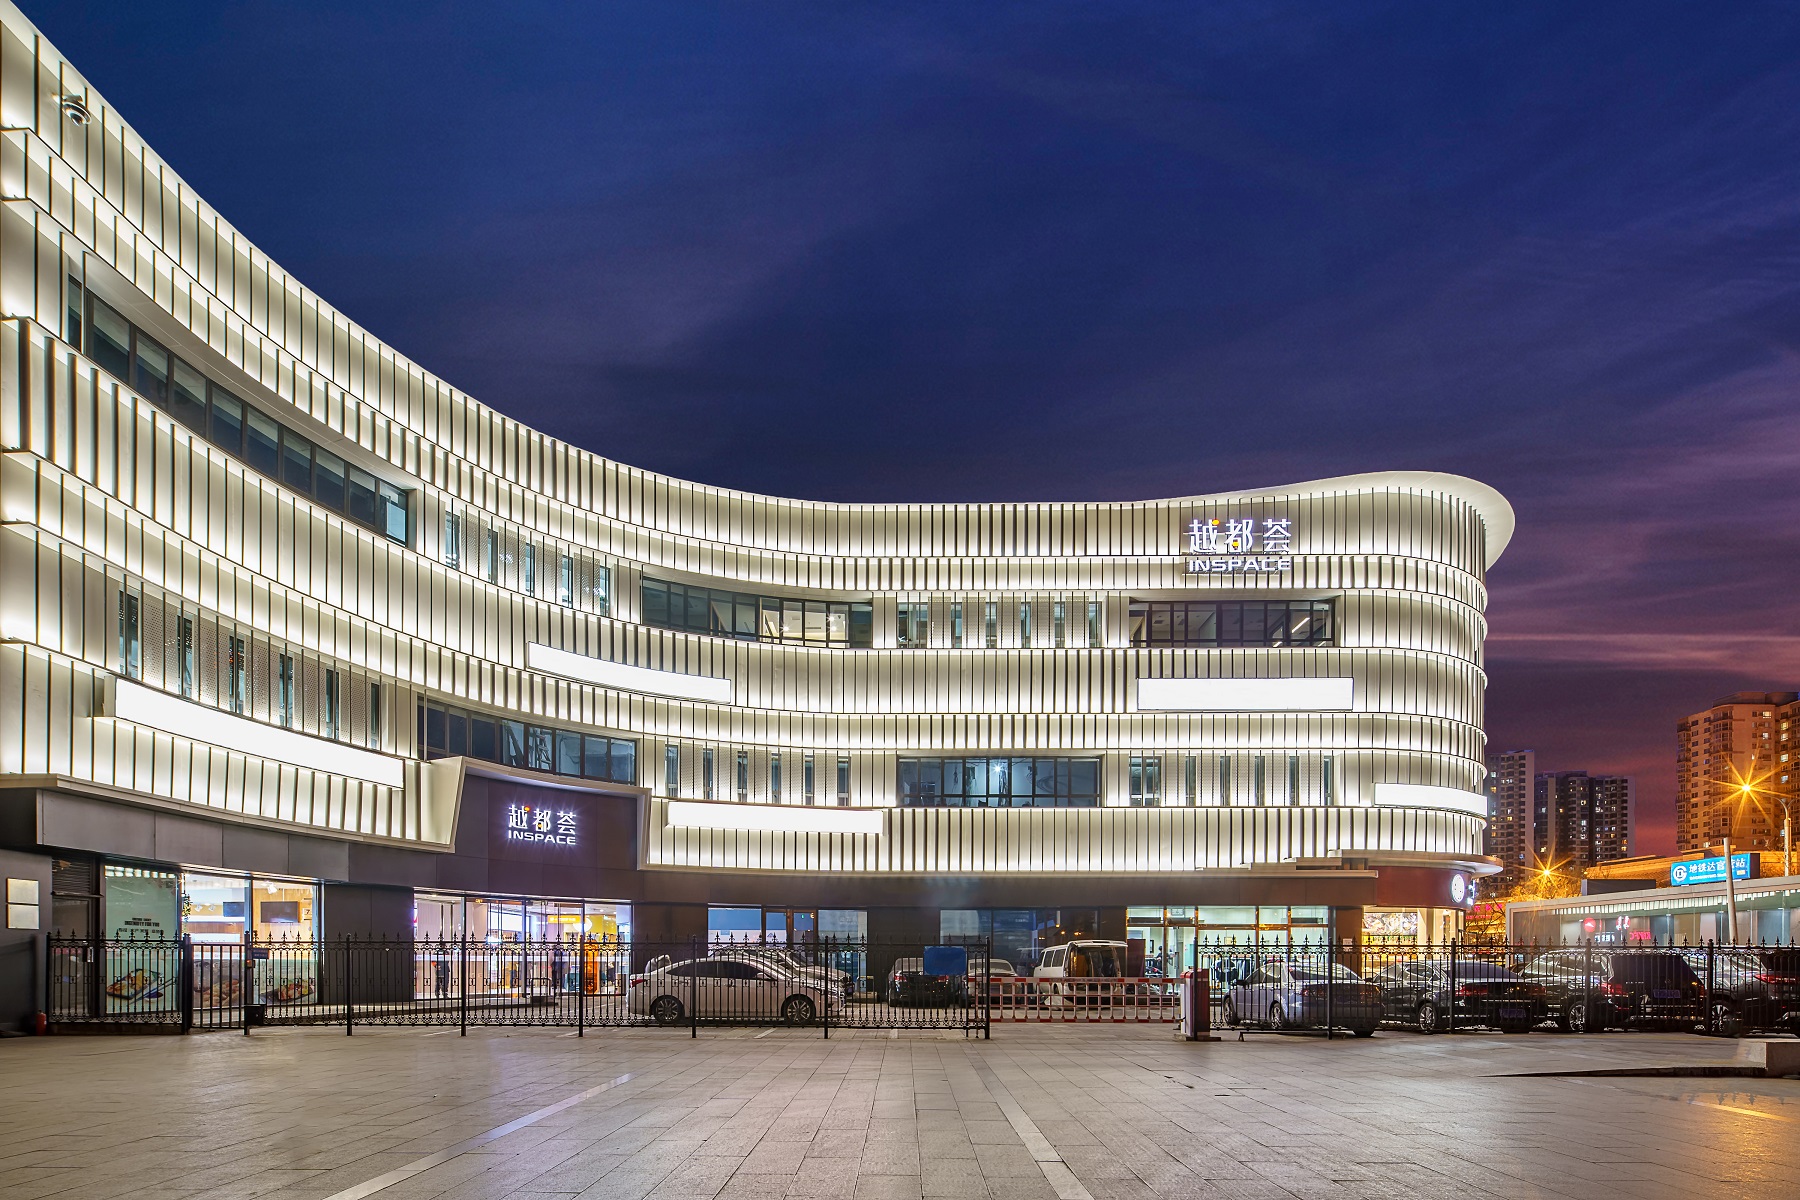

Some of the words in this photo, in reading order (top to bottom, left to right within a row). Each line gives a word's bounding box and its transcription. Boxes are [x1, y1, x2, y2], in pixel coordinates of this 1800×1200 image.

[1188, 518, 1292, 555] 越都荟
[1189, 559, 1291, 573] INSPACE
[508, 804, 577, 835] 越都荟
[508, 829, 577, 845] INSPACE
